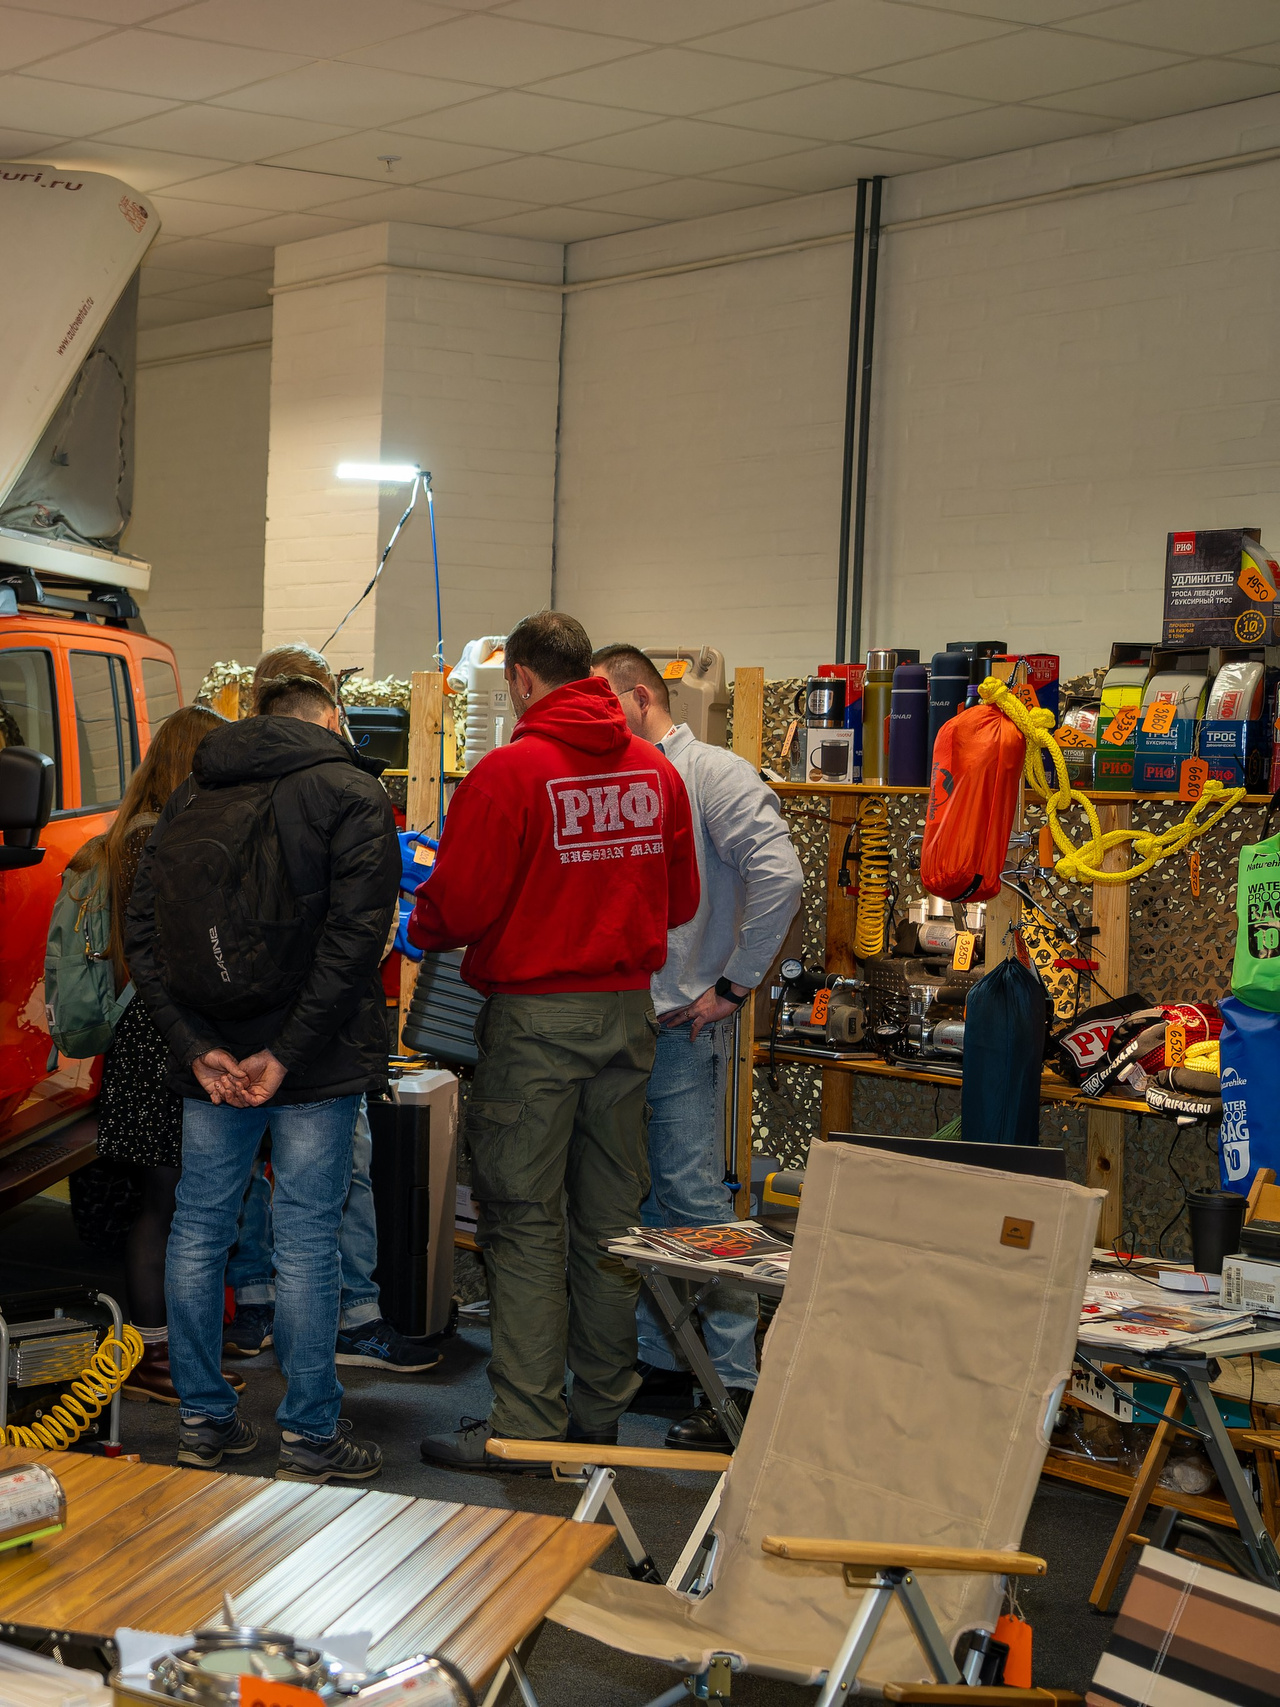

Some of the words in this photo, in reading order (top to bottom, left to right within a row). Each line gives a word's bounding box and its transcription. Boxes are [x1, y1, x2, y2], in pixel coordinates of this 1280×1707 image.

[1176, 543, 1193, 552] РИФ
[1172, 573, 1234, 586] УДЛИНИТЕЛЬ
[1247, 575, 1269, 600] 1950
[1193, 589, 1224, 597] ЛЕБЕДКИ
[1243, 620, 1259, 633] 10
[1151, 708, 1169, 731] 3860
[1207, 732, 1237, 742] ТРОС
[1101, 762, 1132, 775] РИФ
[1145, 767, 1175, 779] РИФ
[1187, 766, 1203, 798] 6680
[558, 781, 660, 837] РИФ
[560, 846, 625, 864] RUSSIAN
[1248, 881, 1280, 894] WATE
[1248, 890, 1280, 904] PROO
[1254, 927, 1279, 951] 10
[209, 925, 231, 983] DAKINE
[958, 938, 970, 965] 3850
[815, 992, 830, 1020] 9230
[1068, 1025, 1115, 1057] РИ
[1170, 1030, 1183, 1064] 6520
[1100, 1040, 1139, 1080] RIF4X4.RU
[1165, 1098, 1211, 1114] RIF4X4.RU
[1223, 1100, 1247, 1112] ATER
[1222, 1110, 1247, 1122] OOF
